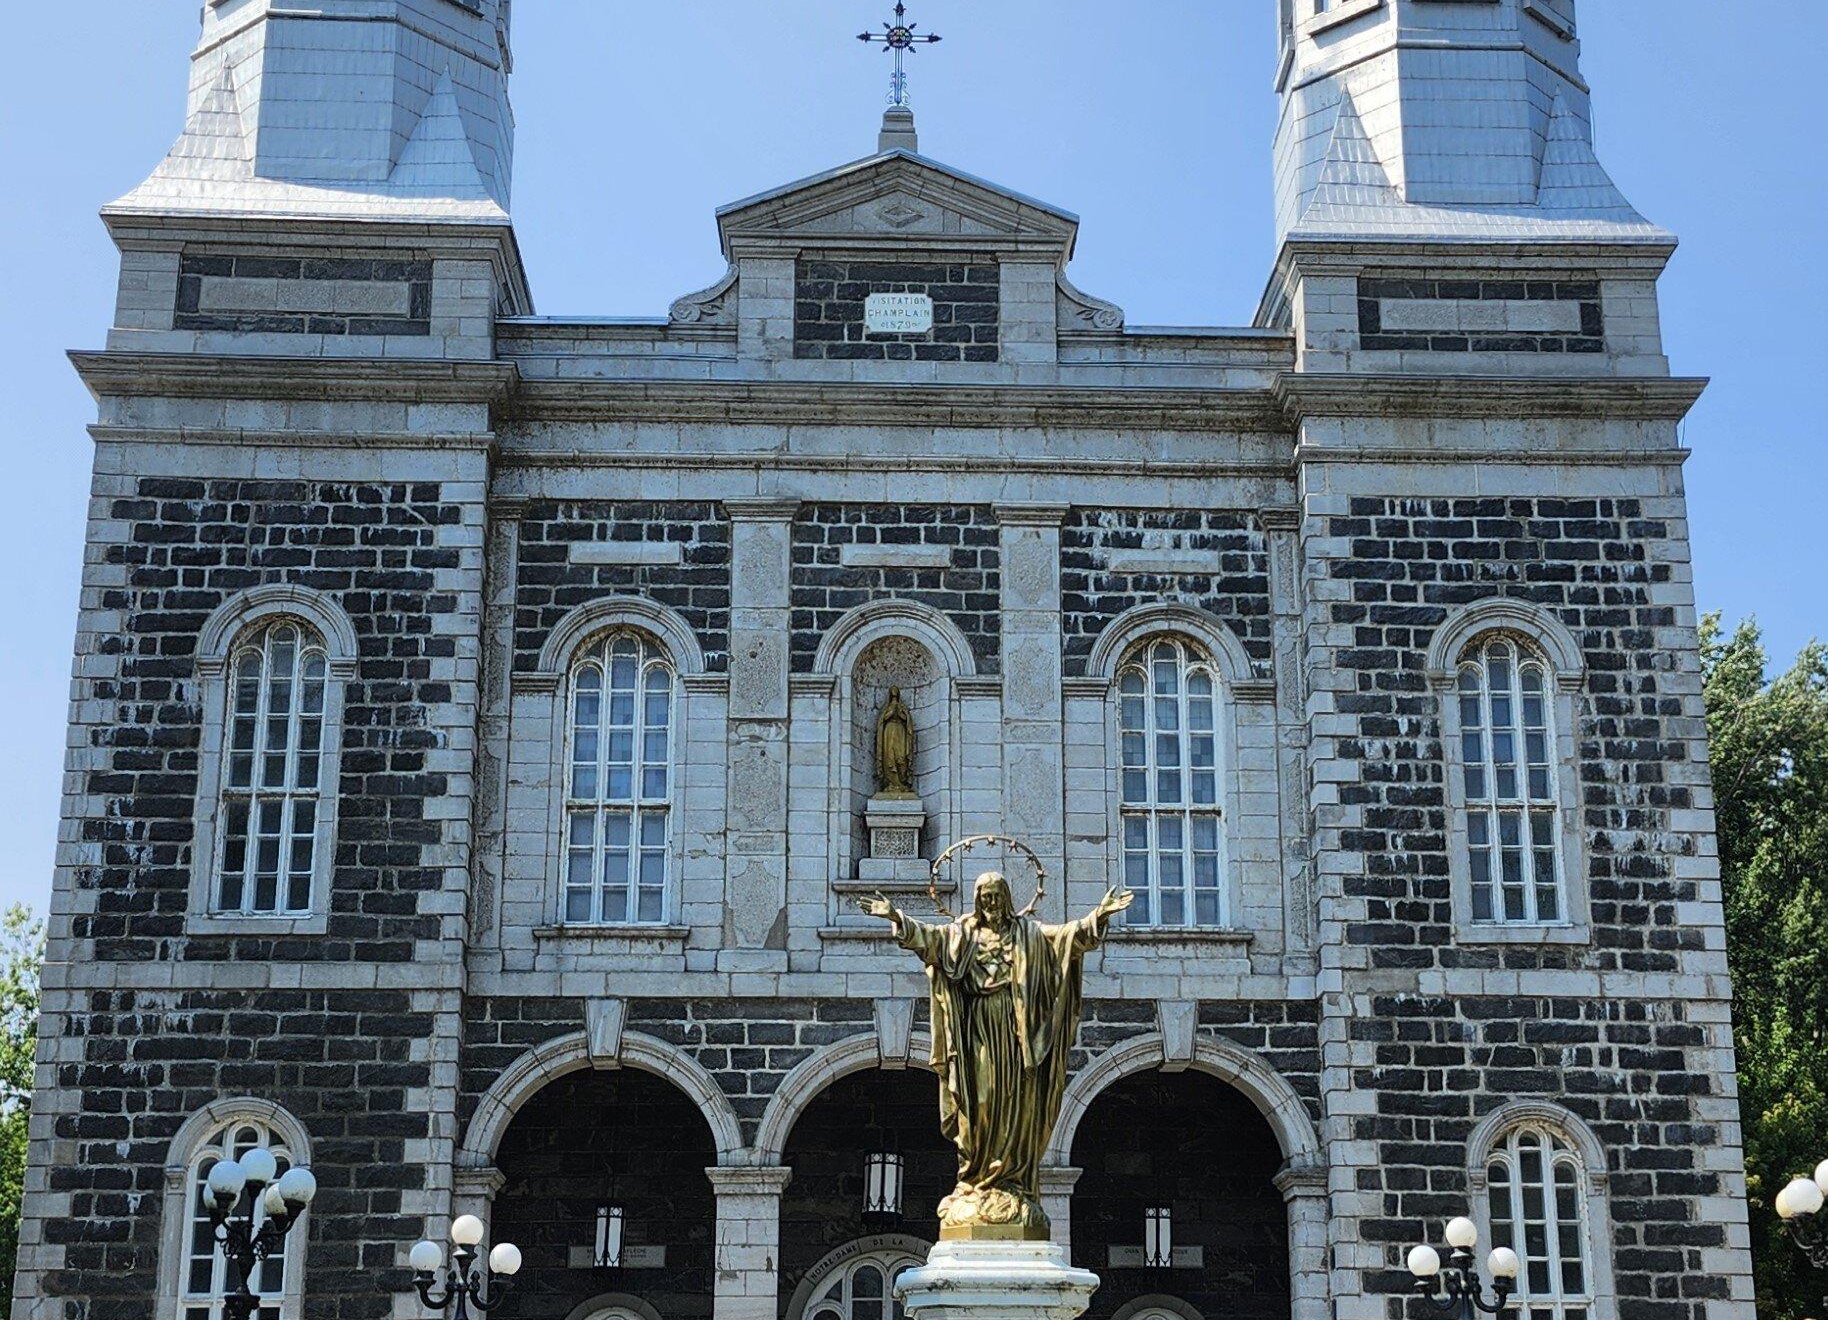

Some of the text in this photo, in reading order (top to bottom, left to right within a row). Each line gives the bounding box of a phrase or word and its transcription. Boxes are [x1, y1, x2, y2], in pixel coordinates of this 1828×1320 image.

[871, 297, 926, 305] VISITATION
[868, 309, 930, 317] CHAMPLAIN
[811, 1244, 858, 1280] NOTRE-DAME
